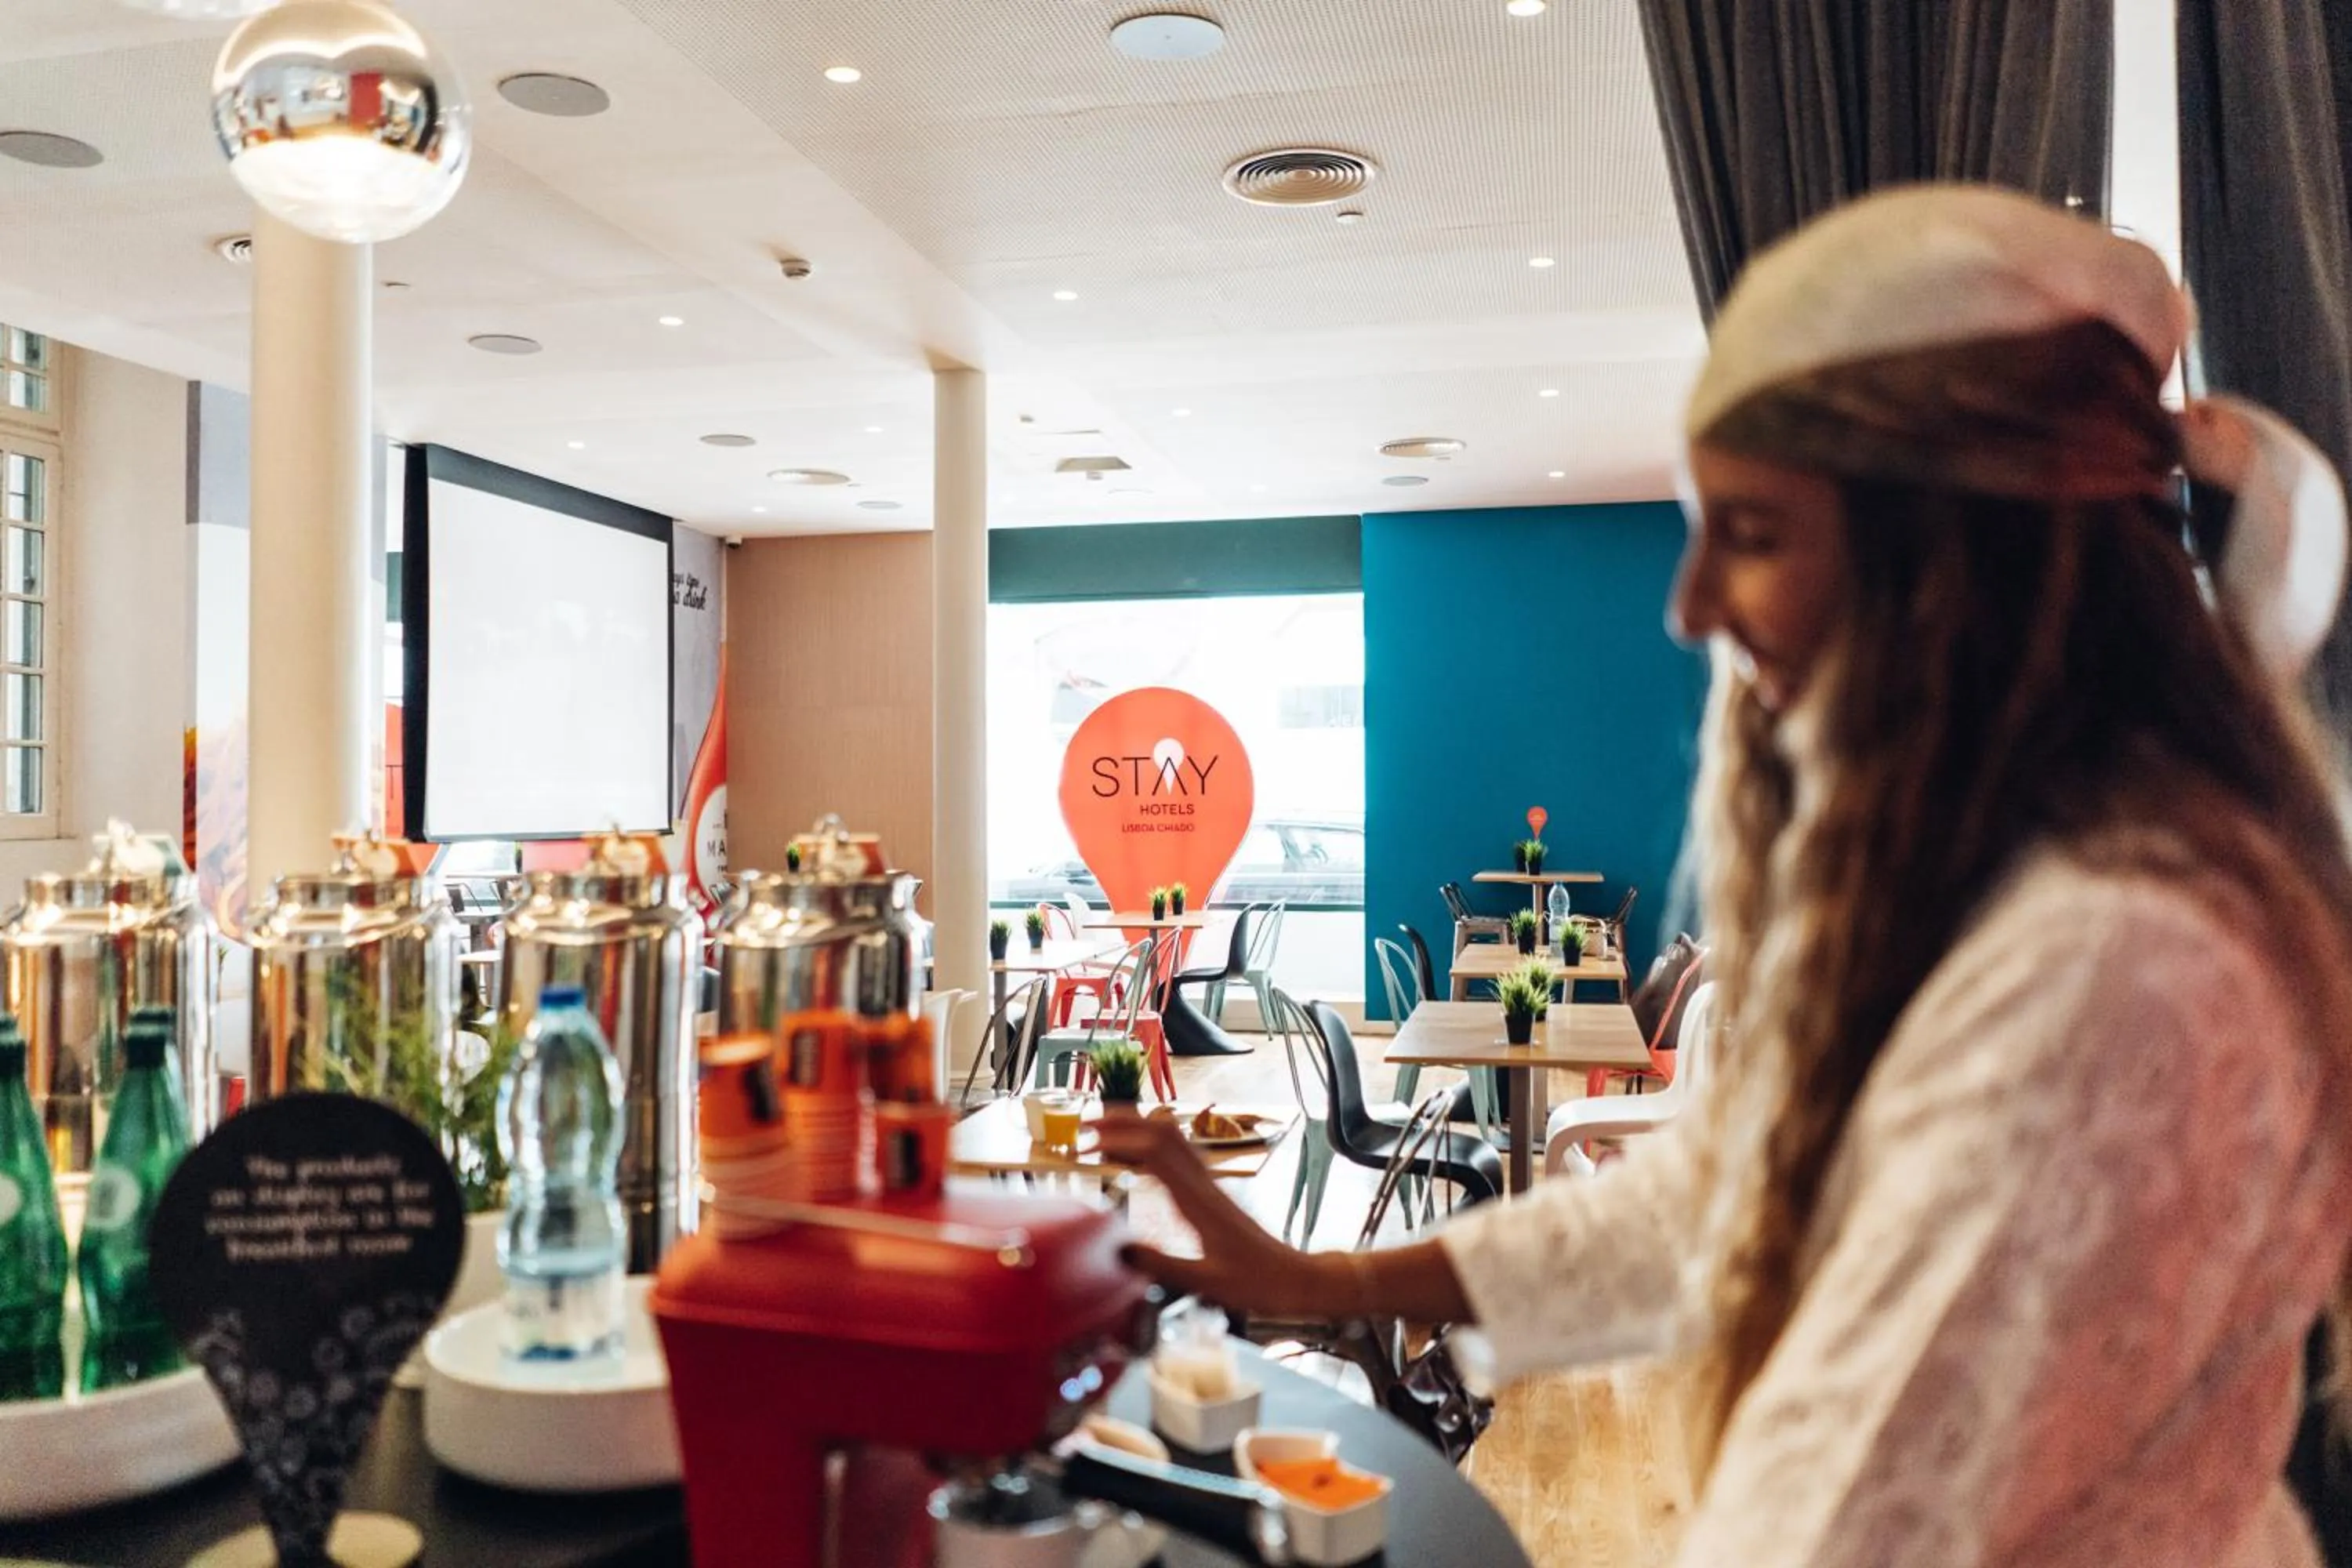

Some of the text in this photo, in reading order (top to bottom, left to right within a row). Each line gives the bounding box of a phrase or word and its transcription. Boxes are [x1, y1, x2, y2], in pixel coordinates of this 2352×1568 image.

[1092, 755, 1218, 797] STAY
[1140, 804, 1195, 815] HOTELS
[1122, 822, 1195, 833] LISBOA CHIADO
